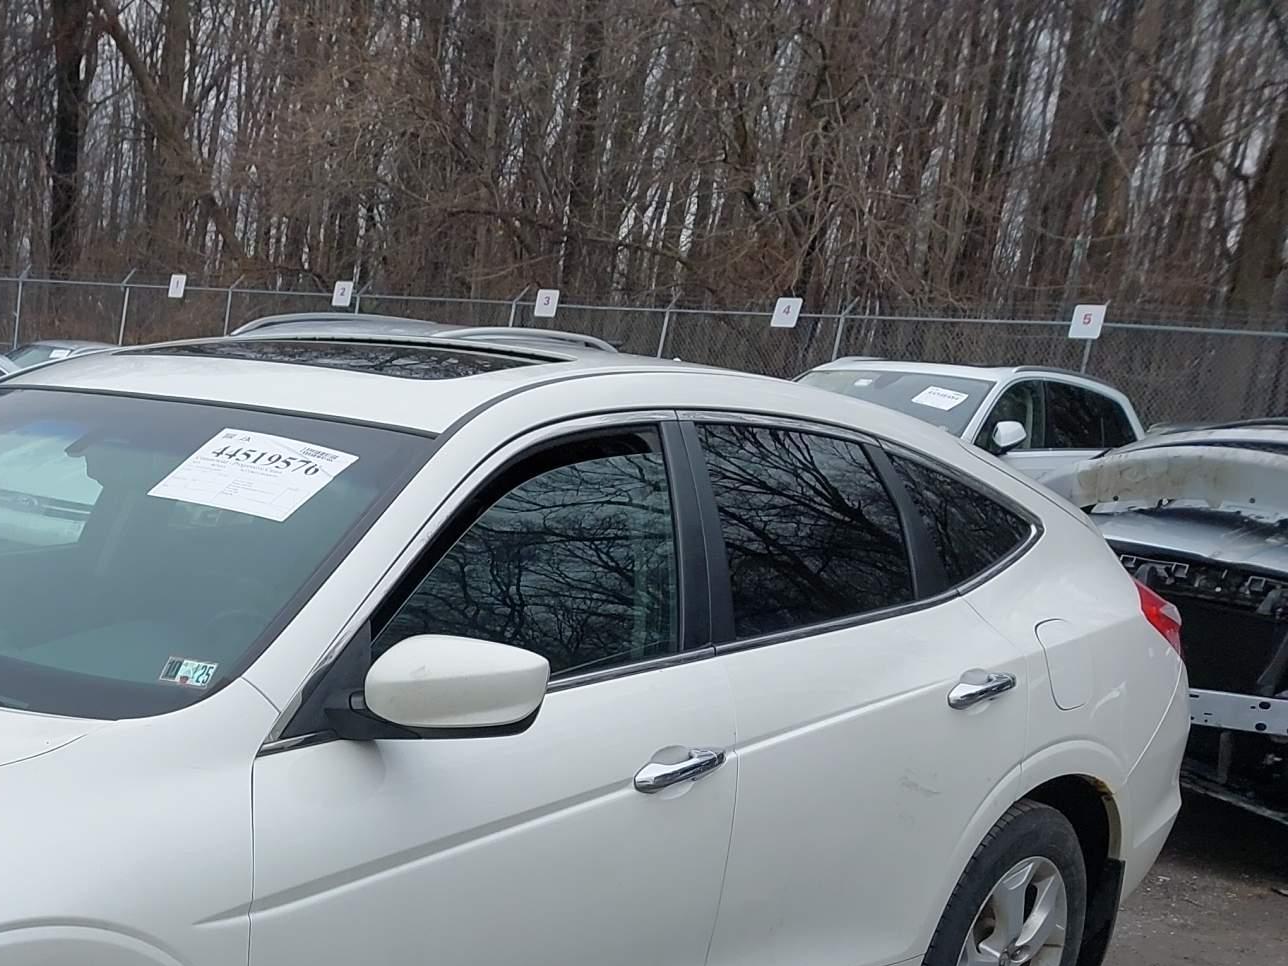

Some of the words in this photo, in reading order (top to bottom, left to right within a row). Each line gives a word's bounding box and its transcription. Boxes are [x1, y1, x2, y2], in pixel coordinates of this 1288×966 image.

[543, 296, 551, 306] 3
[782, 305, 792, 315] 4
[1082, 313, 1093, 325] 5
[211, 445, 319, 476] 44519576
[196, 664, 214, 684] 25
